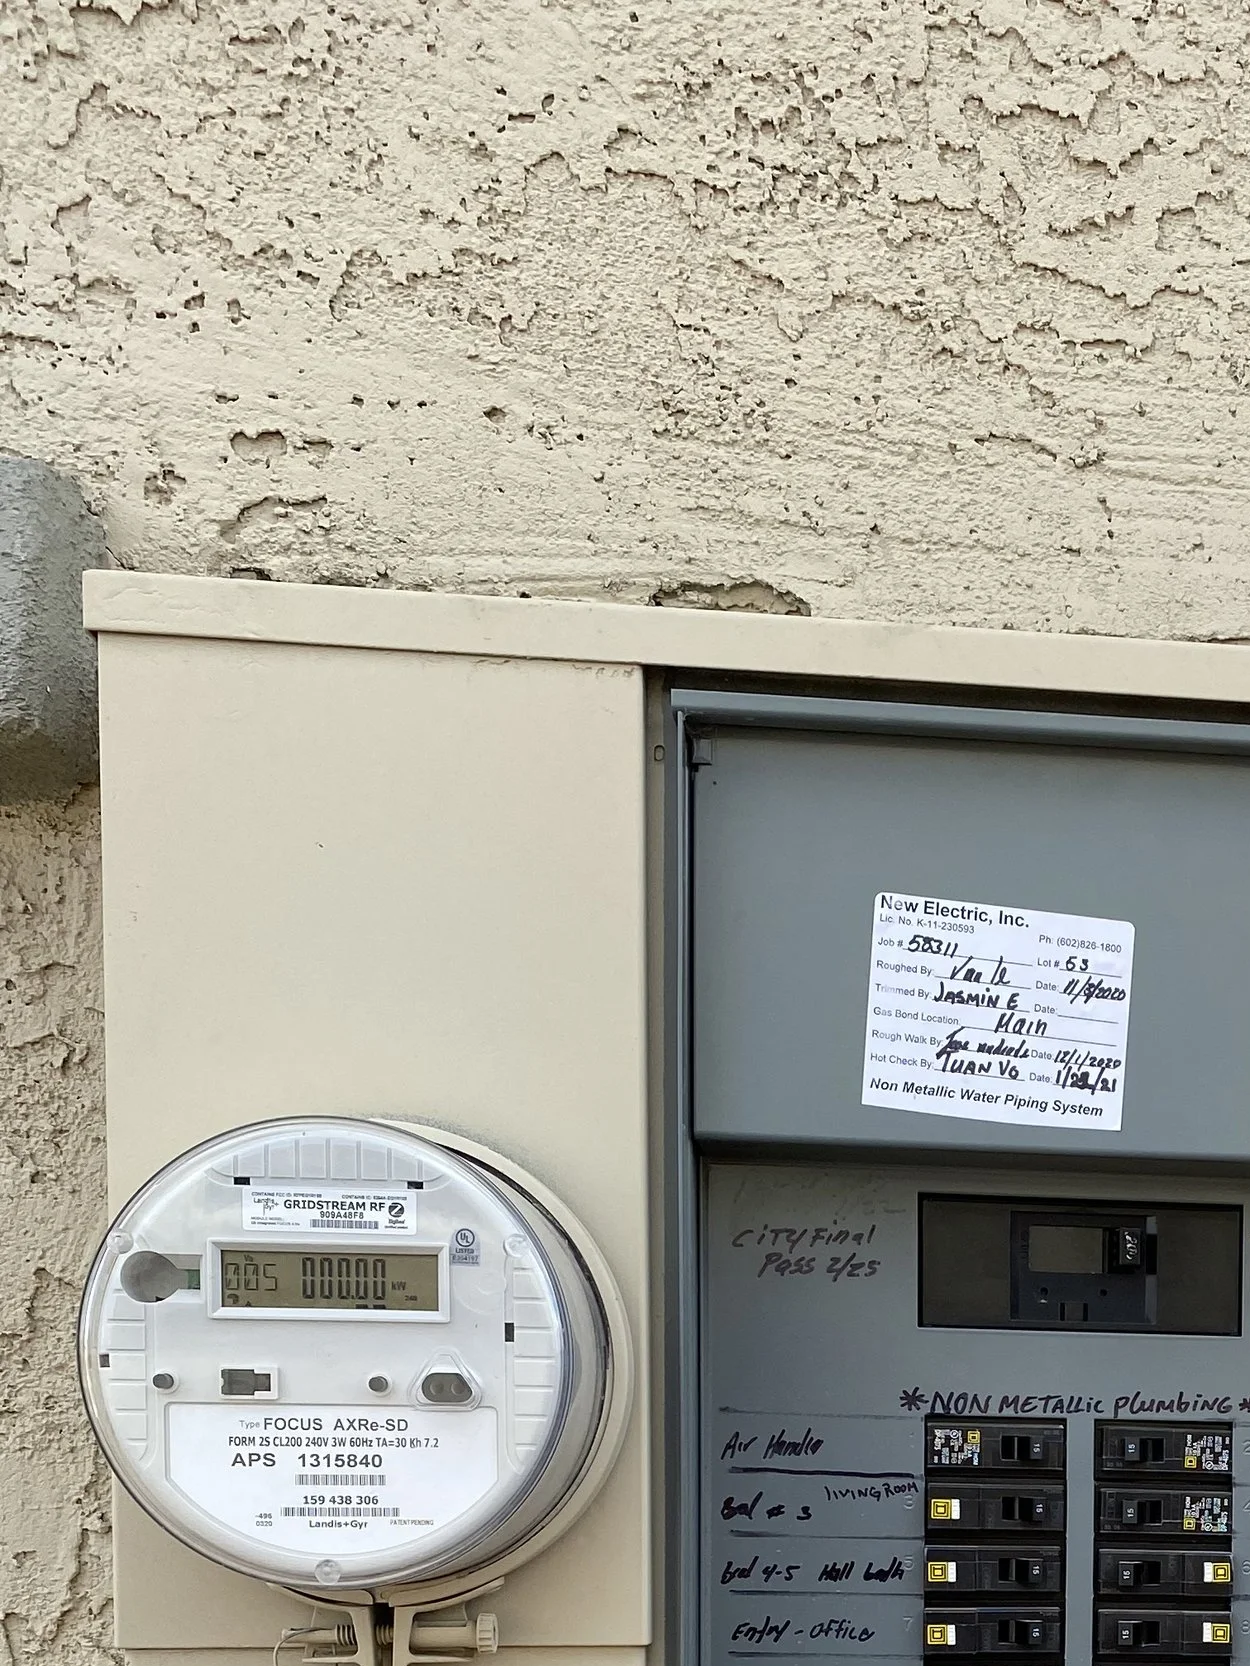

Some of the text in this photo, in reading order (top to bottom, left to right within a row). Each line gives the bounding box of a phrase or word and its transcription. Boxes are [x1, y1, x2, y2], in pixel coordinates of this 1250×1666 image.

[880, 894, 1029, 928] New Electric, Inc.
[1036, 981, 1060, 992] Date:
[994, 1012, 1048, 1036] Main
[870, 1078, 1103, 1116] Non Metallic Water Piping System
[283, 1200, 385, 1211] GRIDSTREAM RF
[930, 1391, 993, 1415] NON
[239, 1418, 408, 1431] Type FOCUS AXRe-SD
[229, 1437, 439, 1448] FORM 2S CL200 240V 3W 60Hz TA=30 Kh 7.2
[231, 1453, 382, 1468] APS 1315840
[303, 1496, 378, 1504] 159 438 306
[309, 1520, 367, 1529] Landis+Gyr
